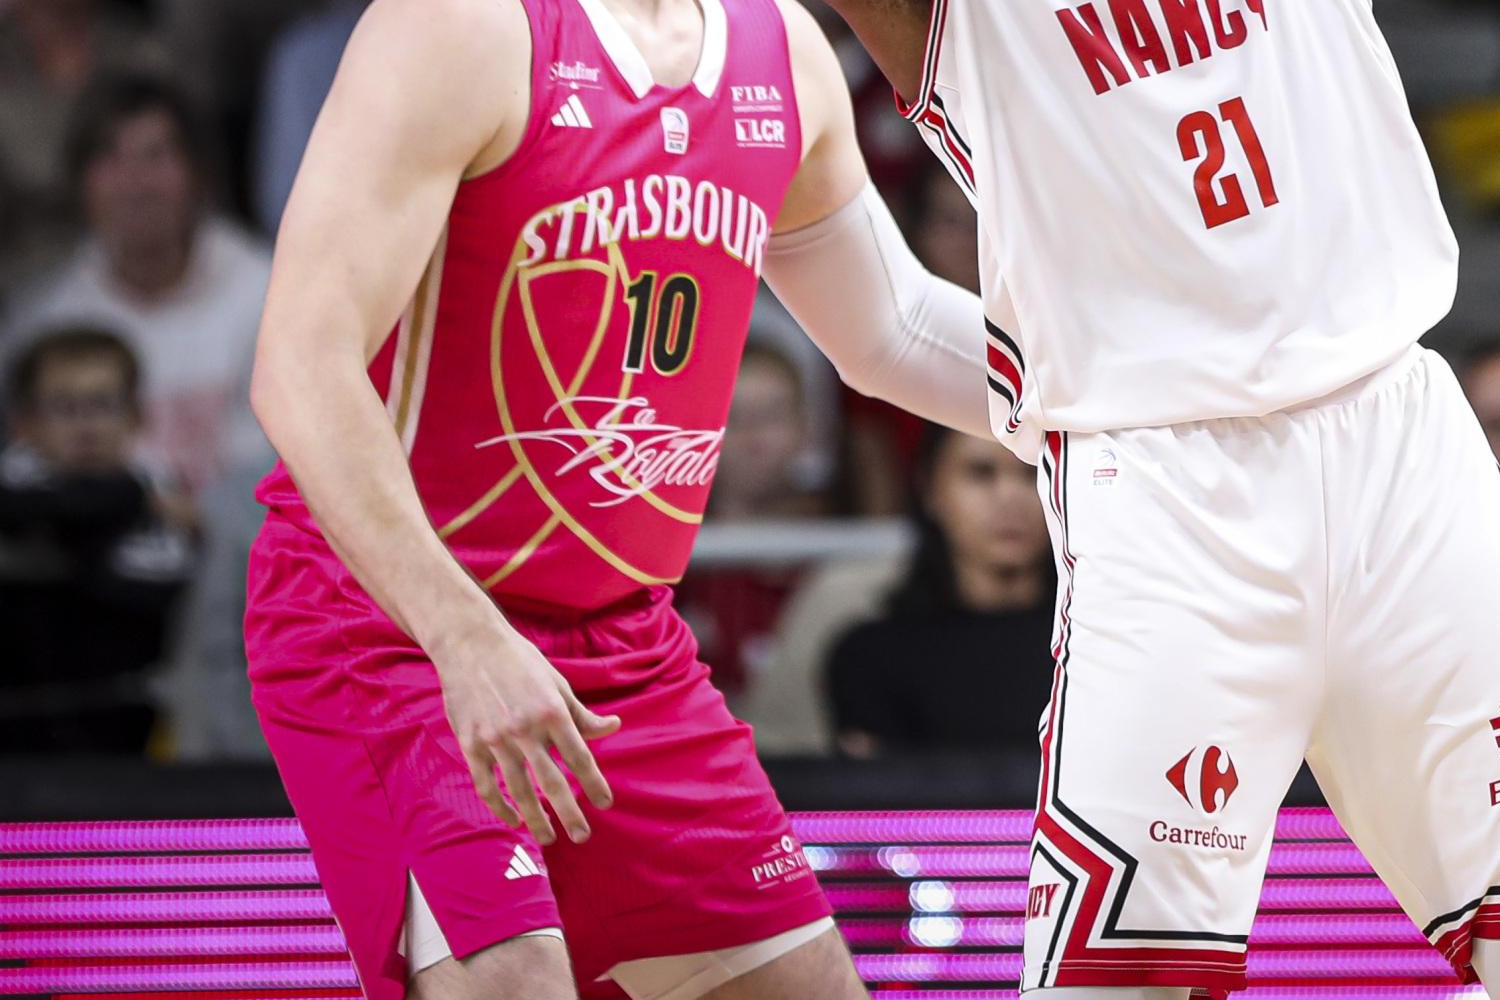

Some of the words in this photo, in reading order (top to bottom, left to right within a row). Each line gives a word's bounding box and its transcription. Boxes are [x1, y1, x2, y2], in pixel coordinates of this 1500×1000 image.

[730, 84, 783, 103] FIBA
[750, 118, 786, 143] LCR
[1175, 96, 1280, 230] 21
[515, 173, 772, 279] STRASBOUR
[621, 269, 702, 378] 10
[1148, 820, 1248, 851] Carrefour
